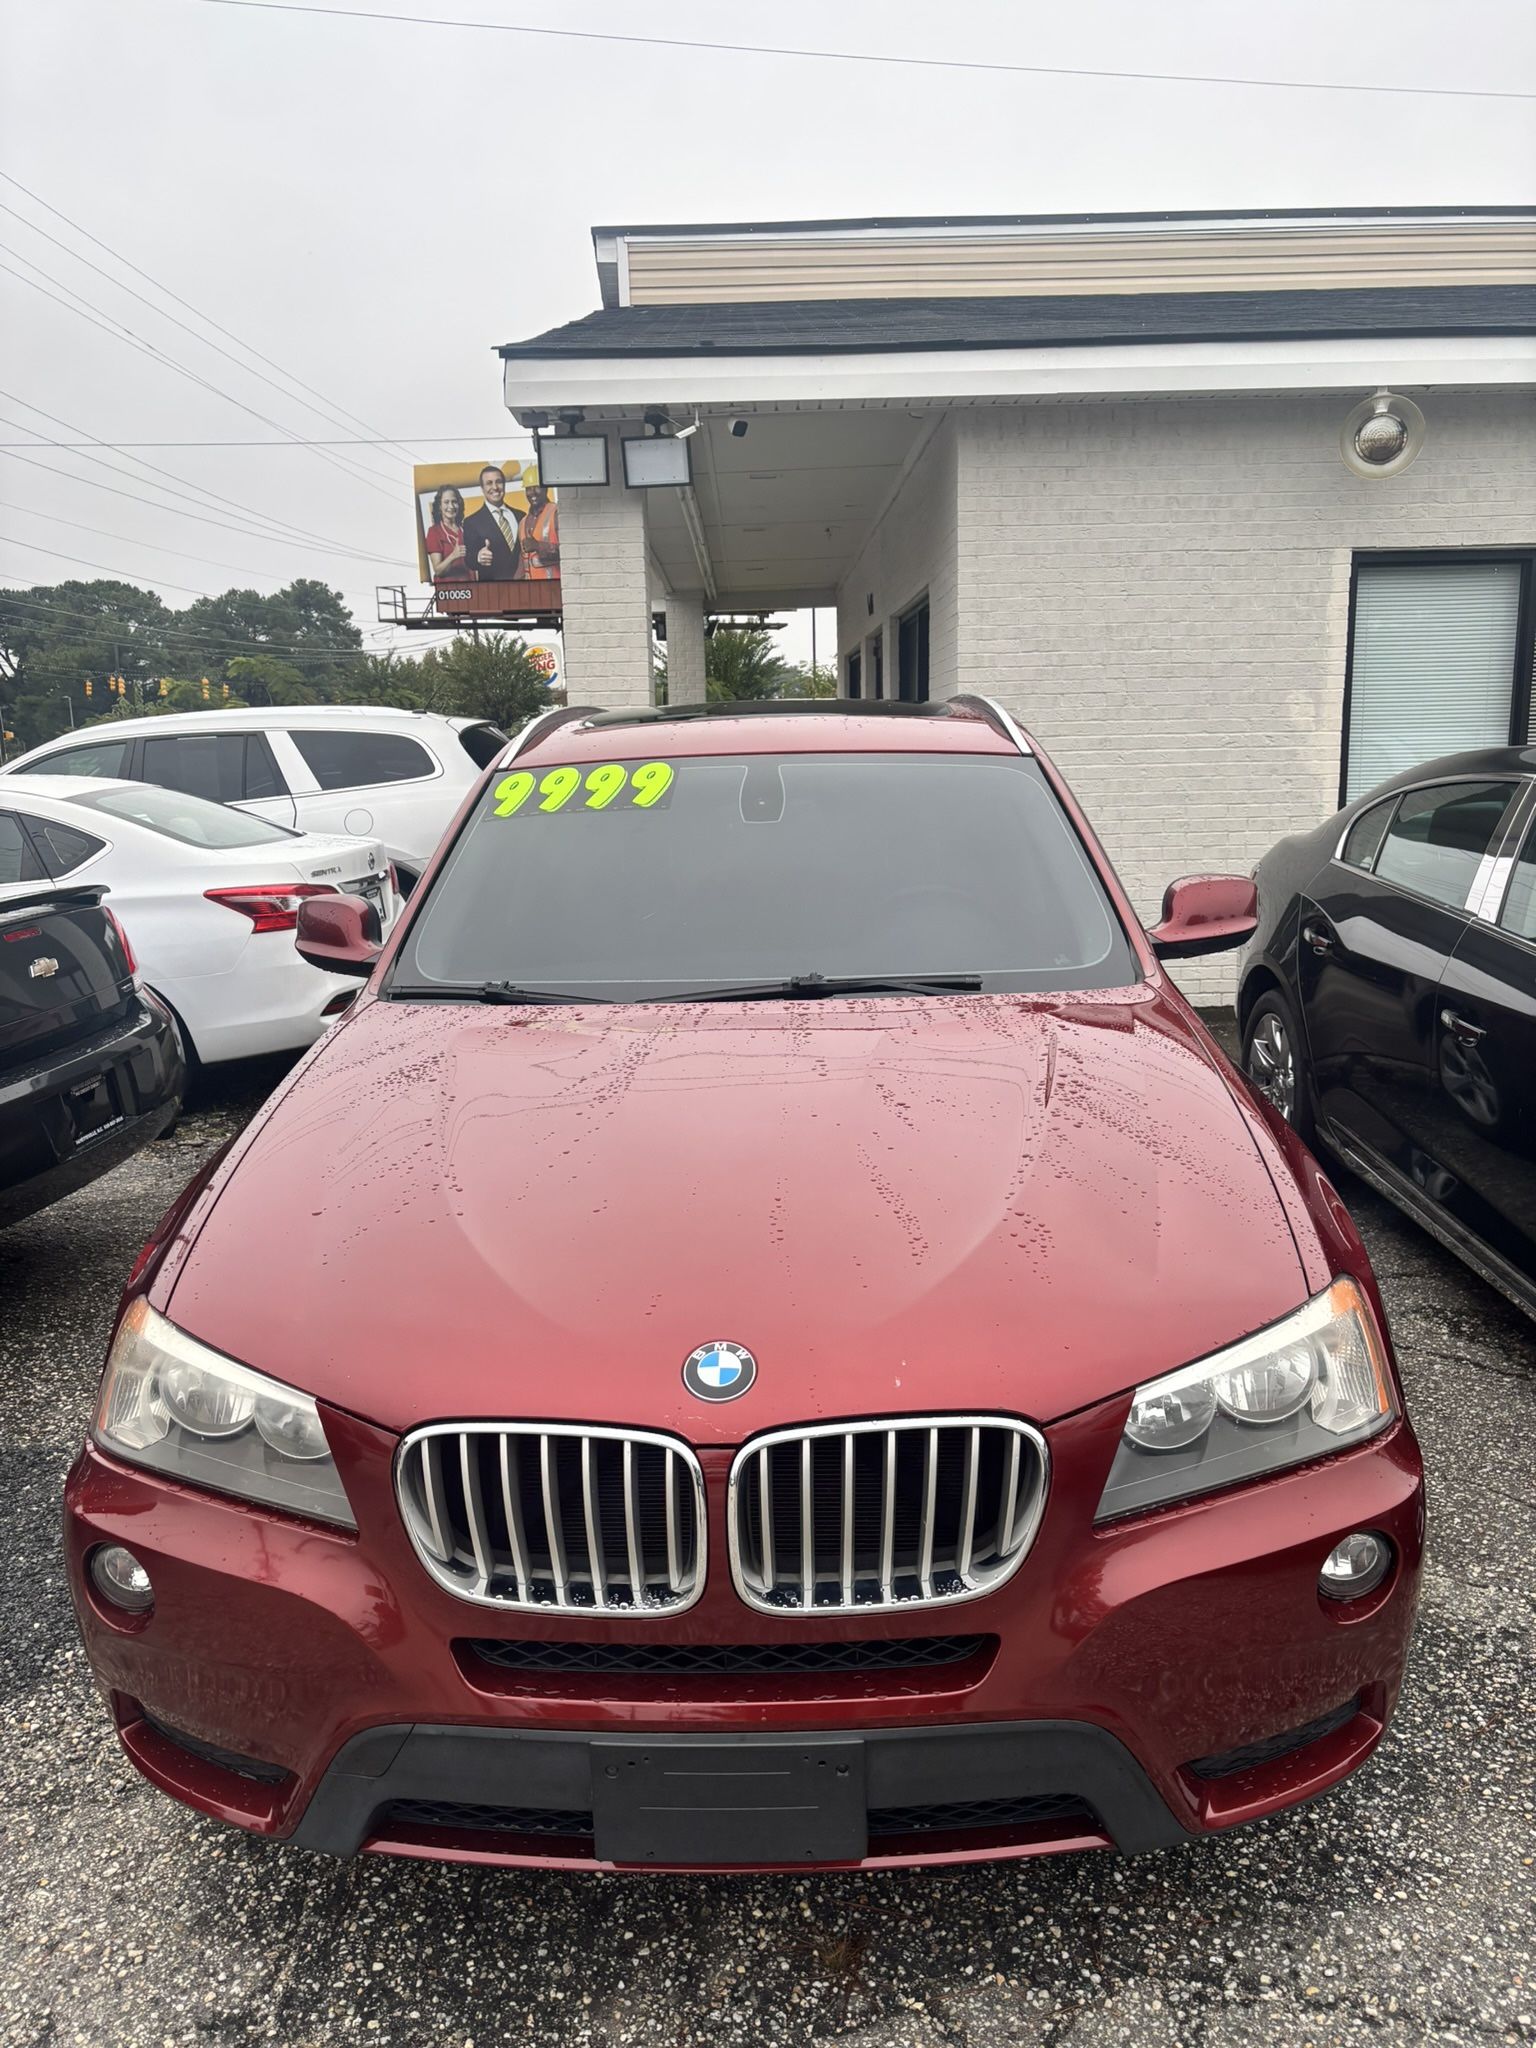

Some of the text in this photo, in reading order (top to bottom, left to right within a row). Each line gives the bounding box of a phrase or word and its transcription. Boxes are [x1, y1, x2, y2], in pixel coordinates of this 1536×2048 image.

[438, 589, 472, 600] 010053
[493, 761, 675, 818] 9999
[692, 1342, 750, 1360] BMW
